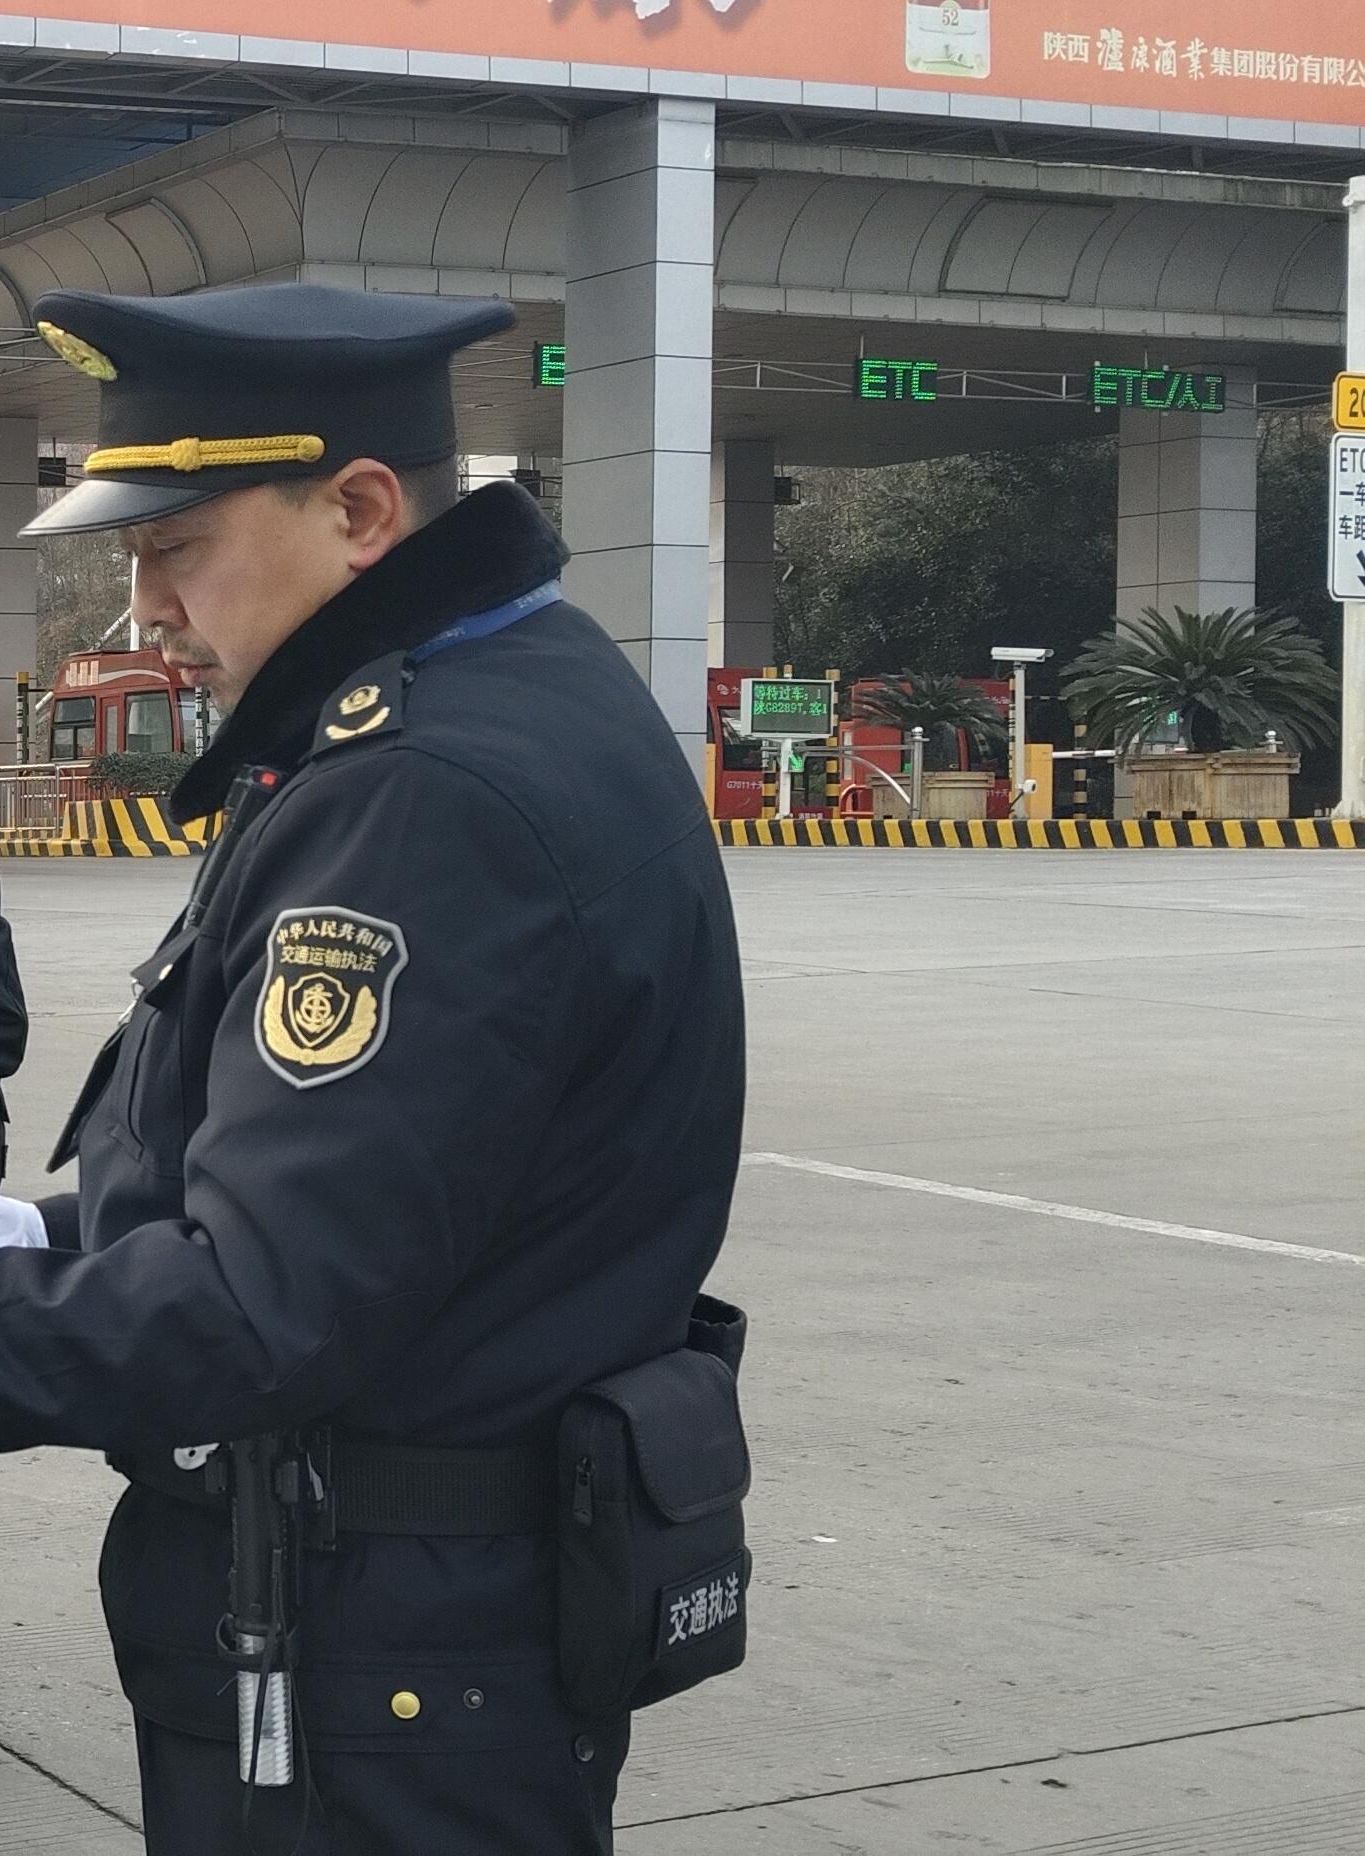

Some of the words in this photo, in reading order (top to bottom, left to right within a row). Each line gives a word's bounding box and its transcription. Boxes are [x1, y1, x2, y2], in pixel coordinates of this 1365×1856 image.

[942, 9, 959, 26] 52
[860, 359, 938, 400] ETC
[276, 919, 393, 957] 中华人民共和国
[280, 944, 378, 973] 交通运输执法
[668, 1571, 739, 1646] 交通执法
